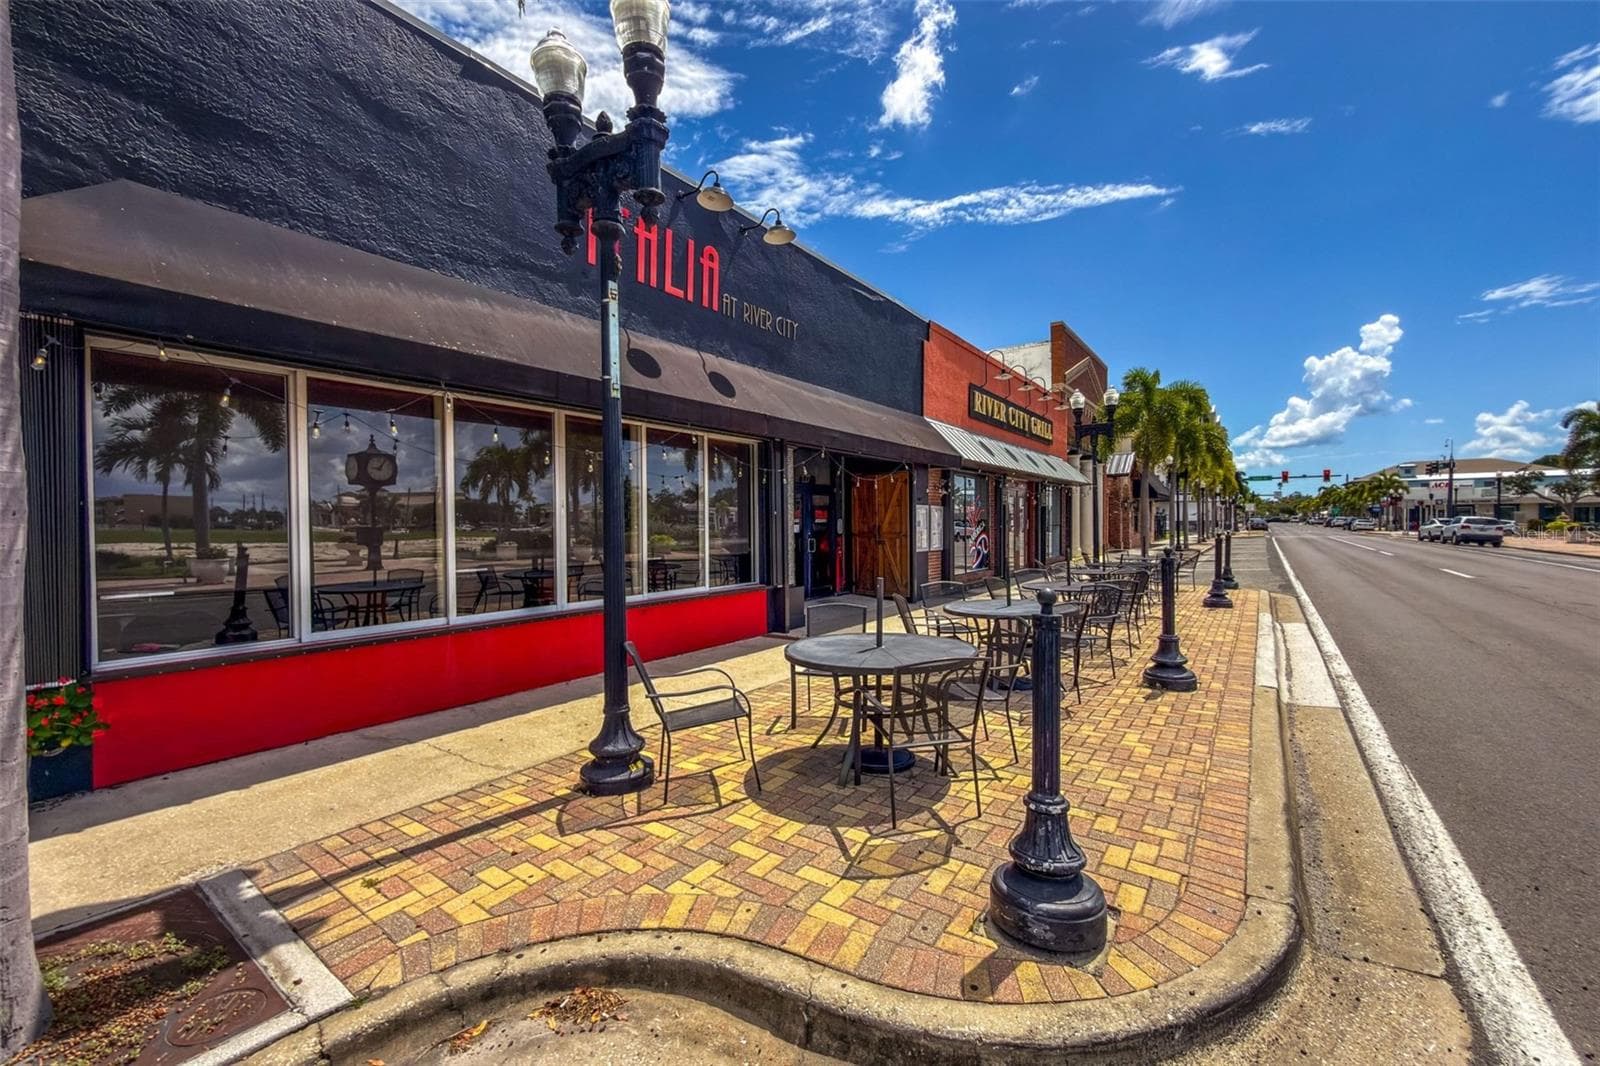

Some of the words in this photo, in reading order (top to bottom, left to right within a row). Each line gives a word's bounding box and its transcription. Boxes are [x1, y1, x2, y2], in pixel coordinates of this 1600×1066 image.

[722, 292, 738, 319] AT
[743, 301, 773, 332] RIVER
[776, 316, 799, 341] CITY
[974, 391, 1007, 422] RIVER
[1008, 406, 1030, 431] CITY
[1031, 416, 1053, 440] GRILL
